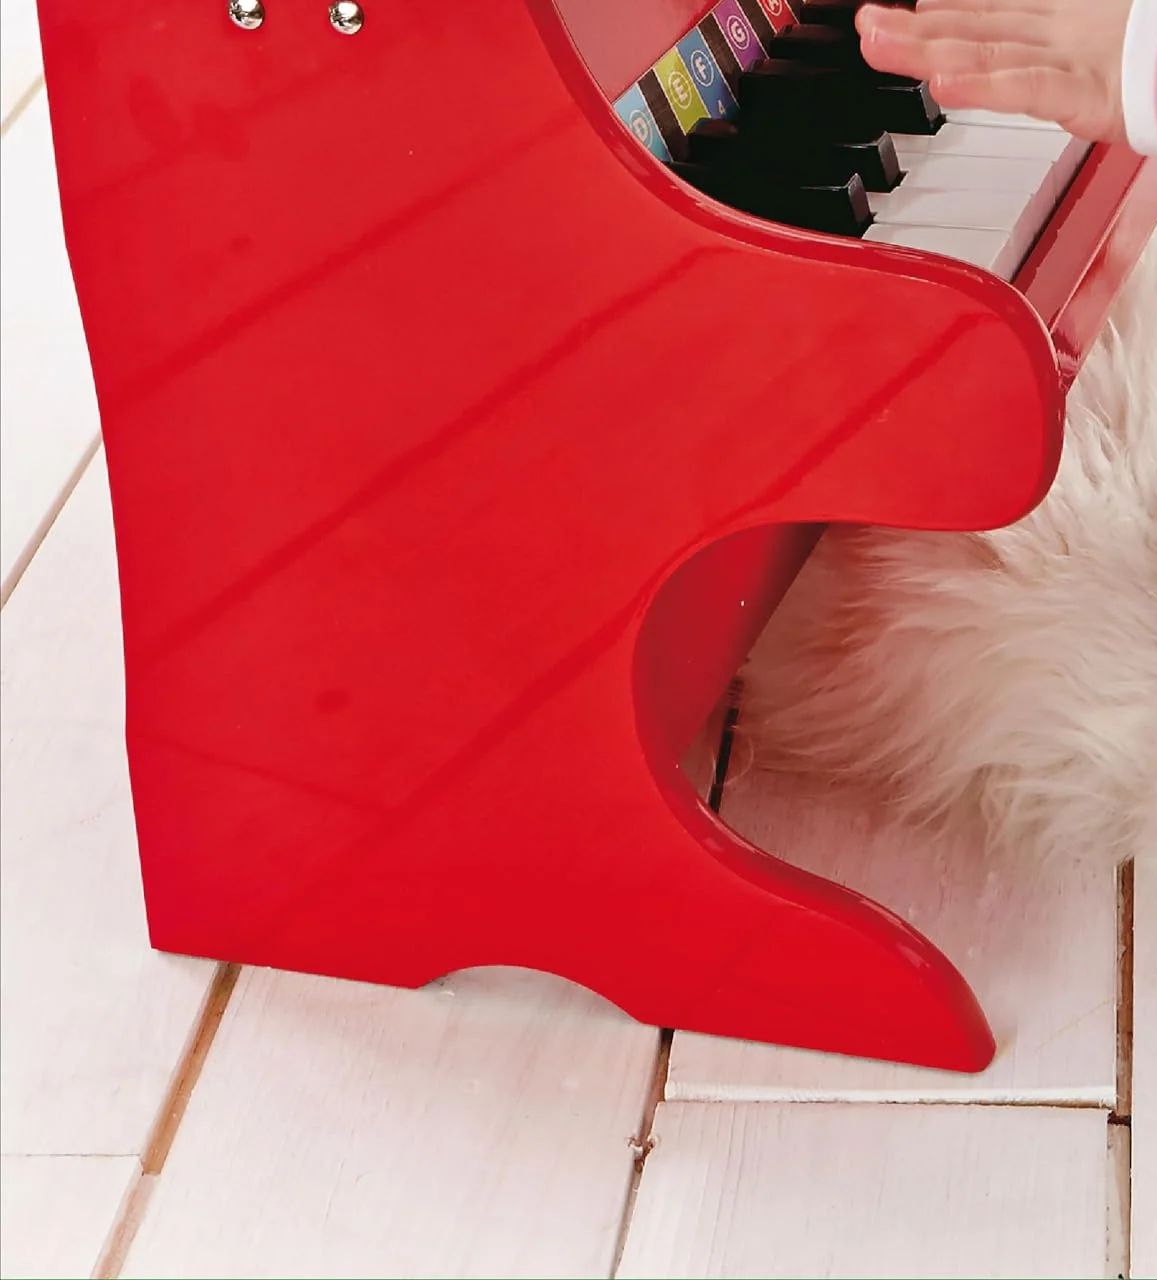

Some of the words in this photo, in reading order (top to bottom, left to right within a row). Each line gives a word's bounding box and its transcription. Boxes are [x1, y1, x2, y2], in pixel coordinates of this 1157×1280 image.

[730, 20, 746, 42] G
[695, 56, 707, 80] F
[672, 78, 689, 102] E
[632, 116, 649, 143] D
